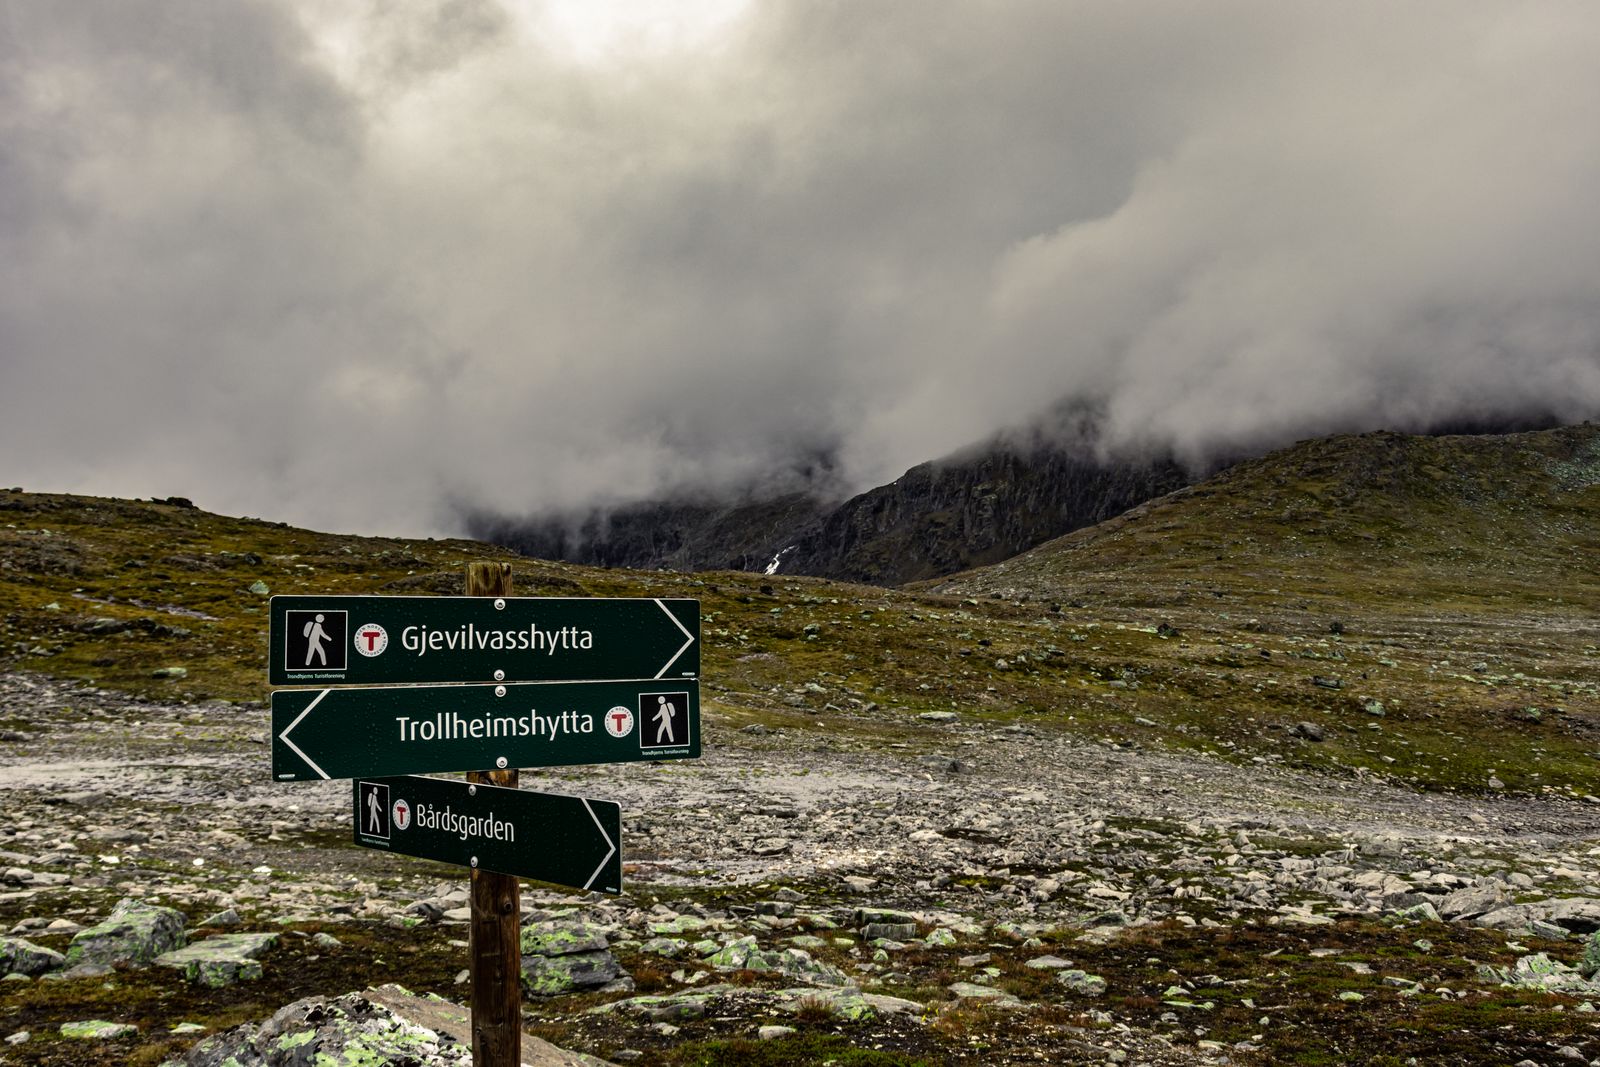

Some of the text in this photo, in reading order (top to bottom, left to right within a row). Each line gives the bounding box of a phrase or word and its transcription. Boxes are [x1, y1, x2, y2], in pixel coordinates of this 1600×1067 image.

[362, 631, 381, 651] T
[401, 623, 593, 657] Gjevilvasshytta
[396, 709, 594, 742] Trollheimshytta
[611, 713, 628, 732] T
[396, 806, 407, 825] T
[416, 803, 515, 843] Bårdsgarden
